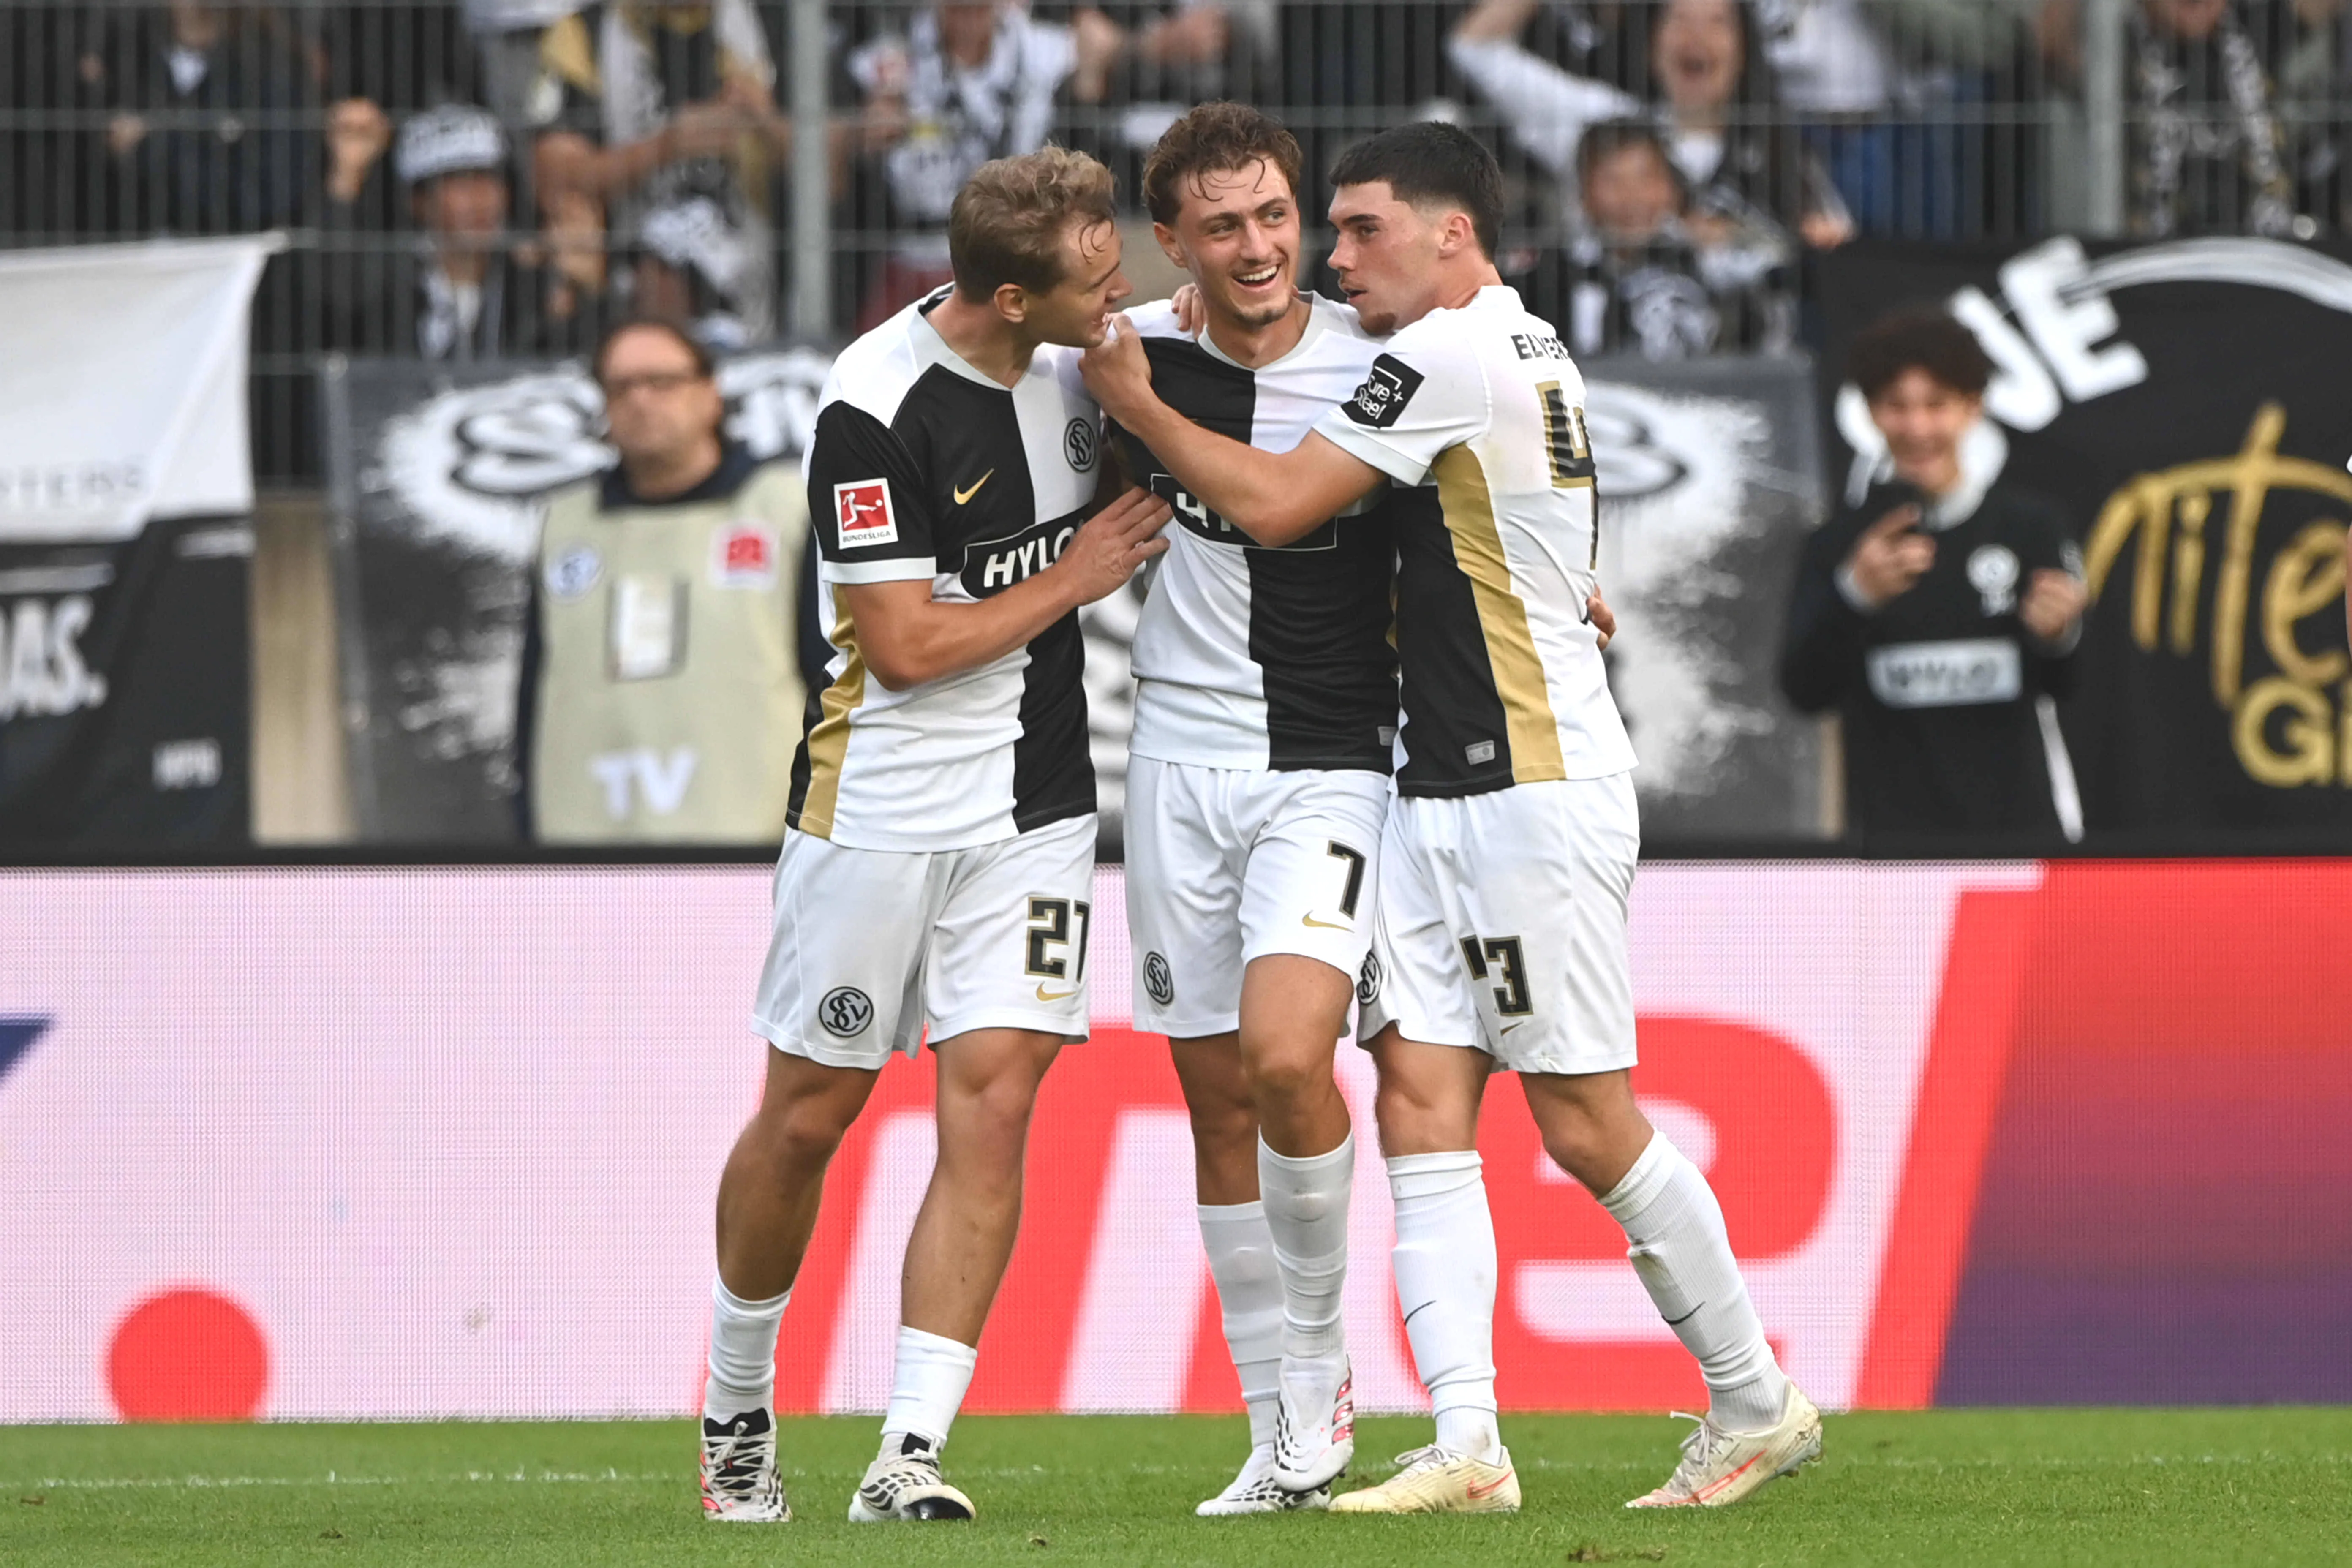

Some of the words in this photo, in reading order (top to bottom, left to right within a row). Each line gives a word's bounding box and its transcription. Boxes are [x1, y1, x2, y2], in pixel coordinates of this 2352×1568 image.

[842, 530, 891, 543] BUNDESLIGA
[0, 593, 108, 720] AS.
[592, 745, 700, 821] TV
[1327, 839, 1367, 921] 7
